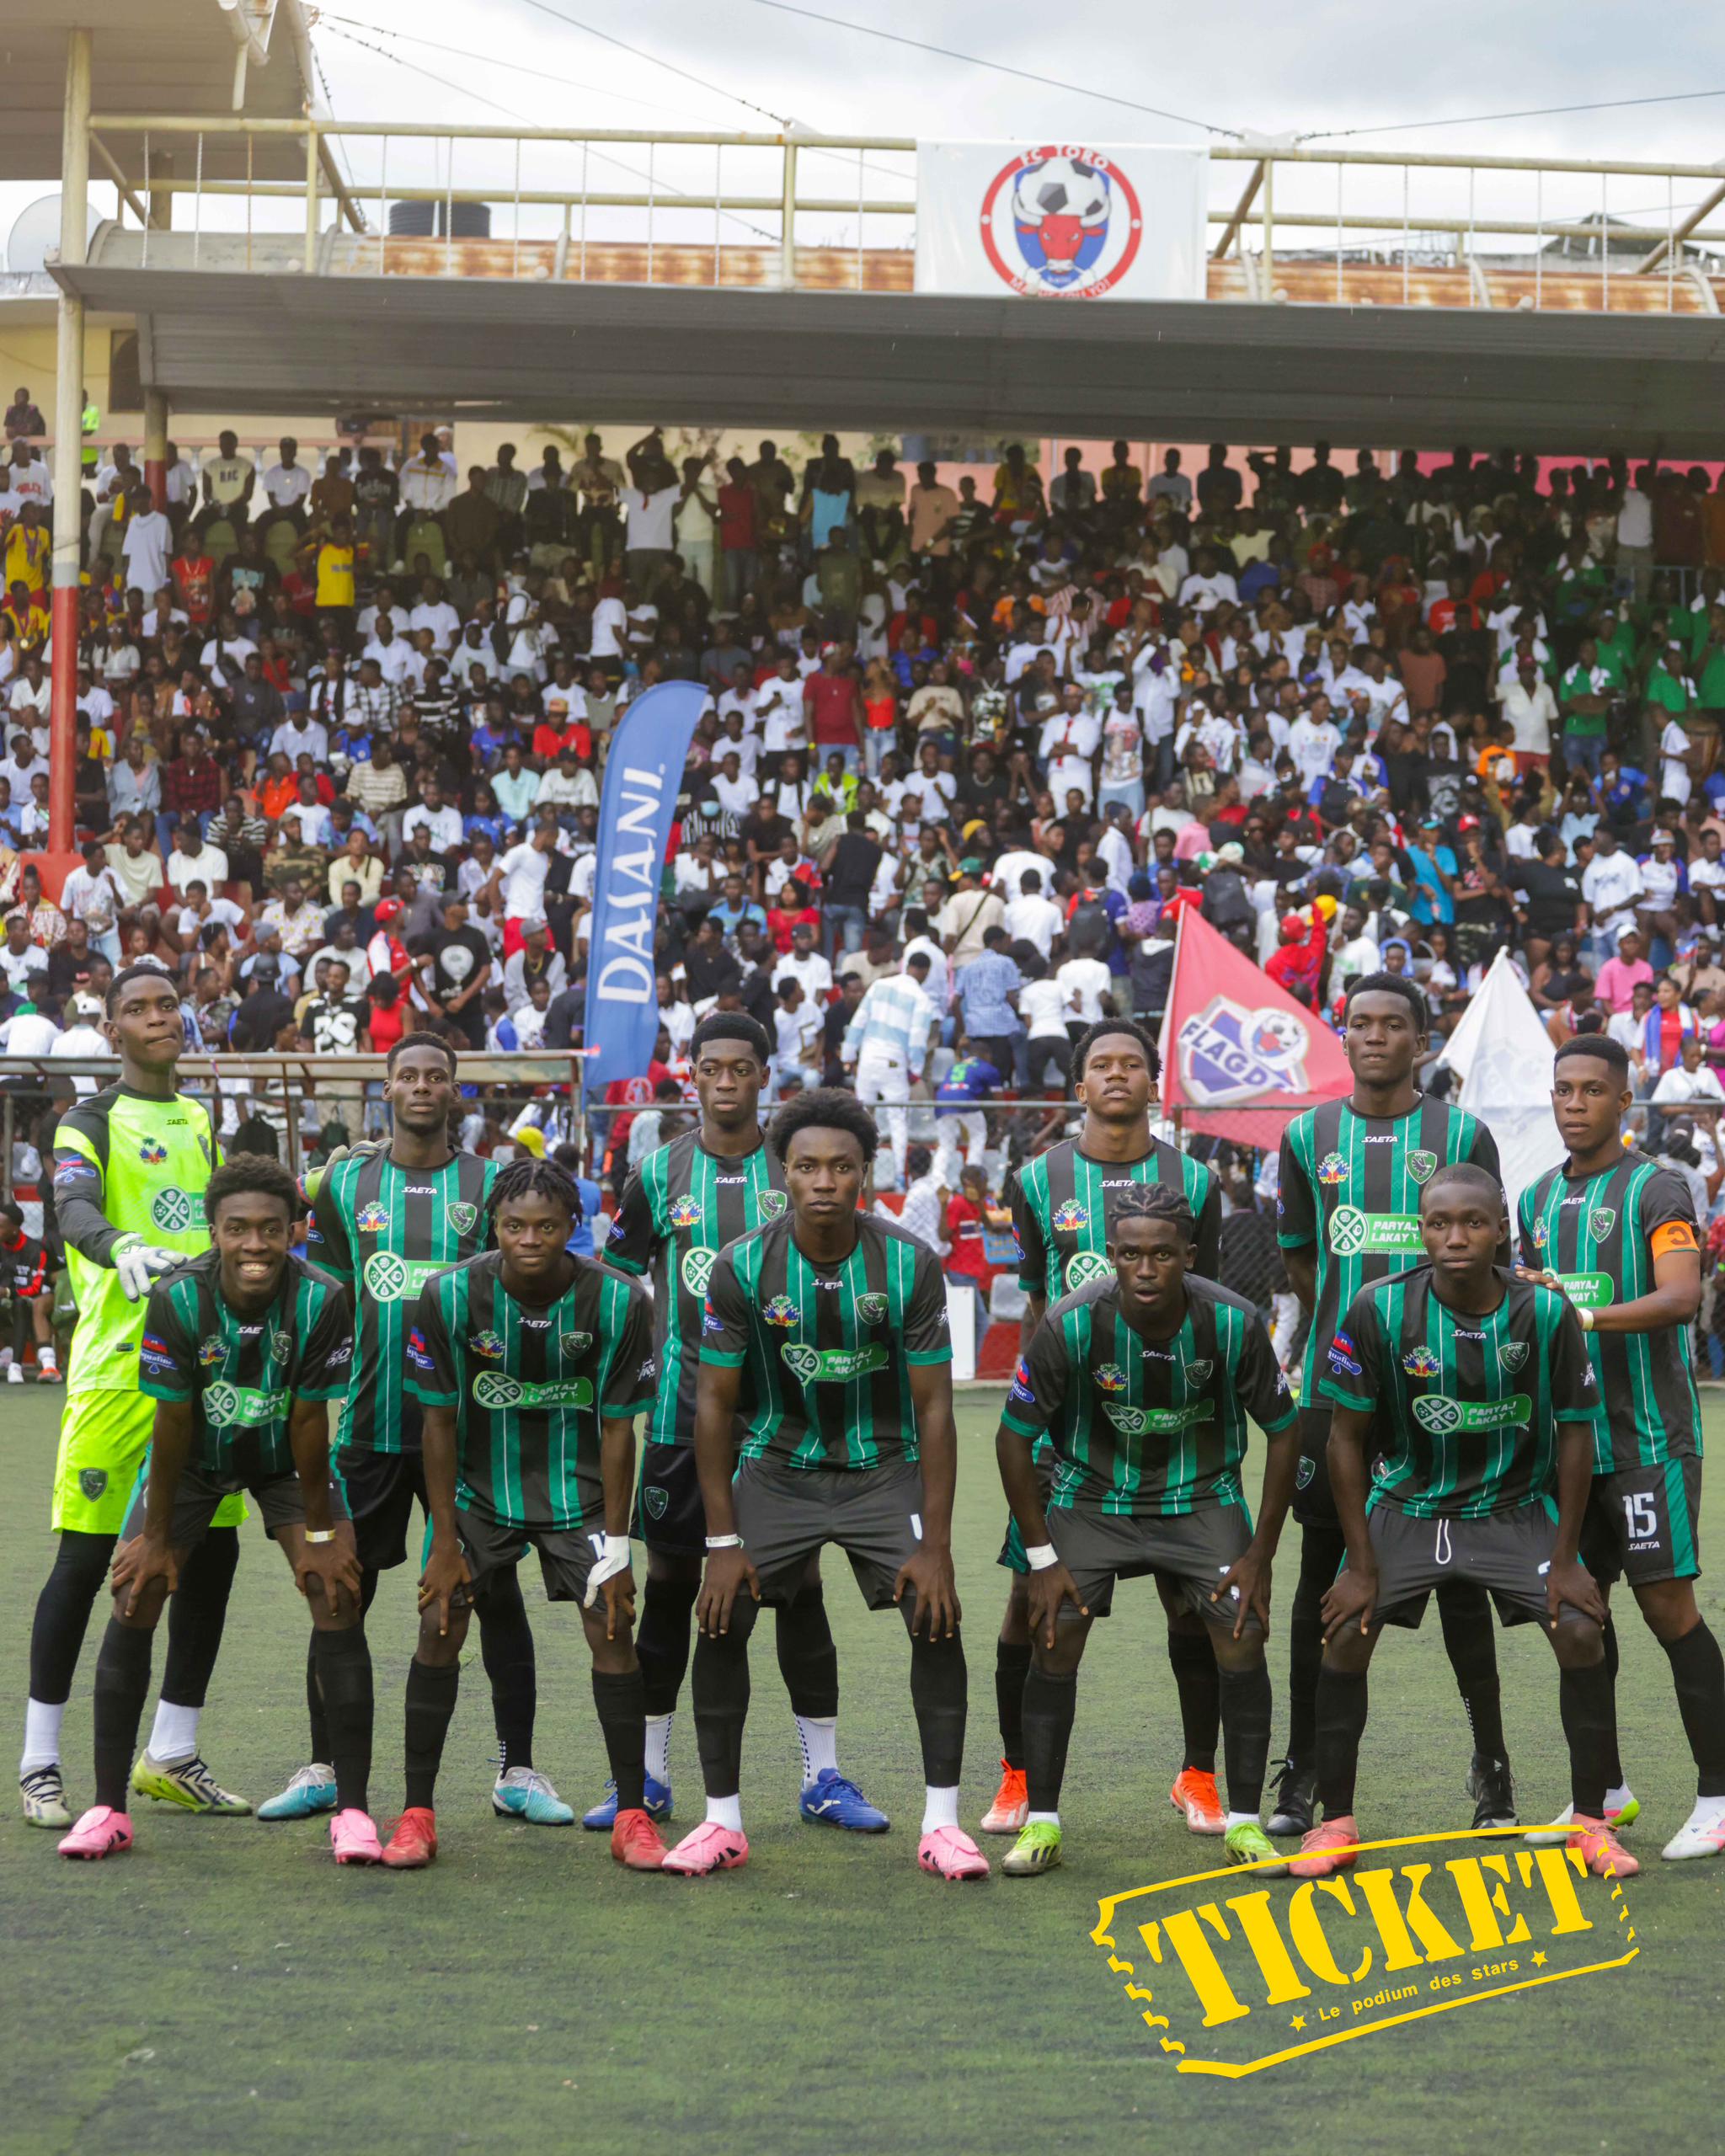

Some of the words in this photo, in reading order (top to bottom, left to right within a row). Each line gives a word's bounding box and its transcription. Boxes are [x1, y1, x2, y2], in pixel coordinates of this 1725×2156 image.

[1020, 149, 1044, 168] FC
[1055, 144, 1110, 170] TORO
[596, 767, 664, 1004] DASANI
[713, 1176, 748, 1184] SAETA
[401, 1186, 438, 1194] SAETA
[1560, 1196, 1586, 1206] SAETA
[1371, 1232, 1410, 1242] LAKAY
[1568, 1293, 1590, 1303] AKAY
[1452, 1329, 1487, 1339] SAETA
[827, 1348, 873, 1364] PARYAJ
[826, 1360, 863, 1374] LAKAY
[1468, 1401, 1517, 1416] PARYAJ
[1467, 1412, 1507, 1426] LAKAY
[1622, 1492, 1657, 1539] 15
[1627, 1540, 1660, 1550] SAETA
